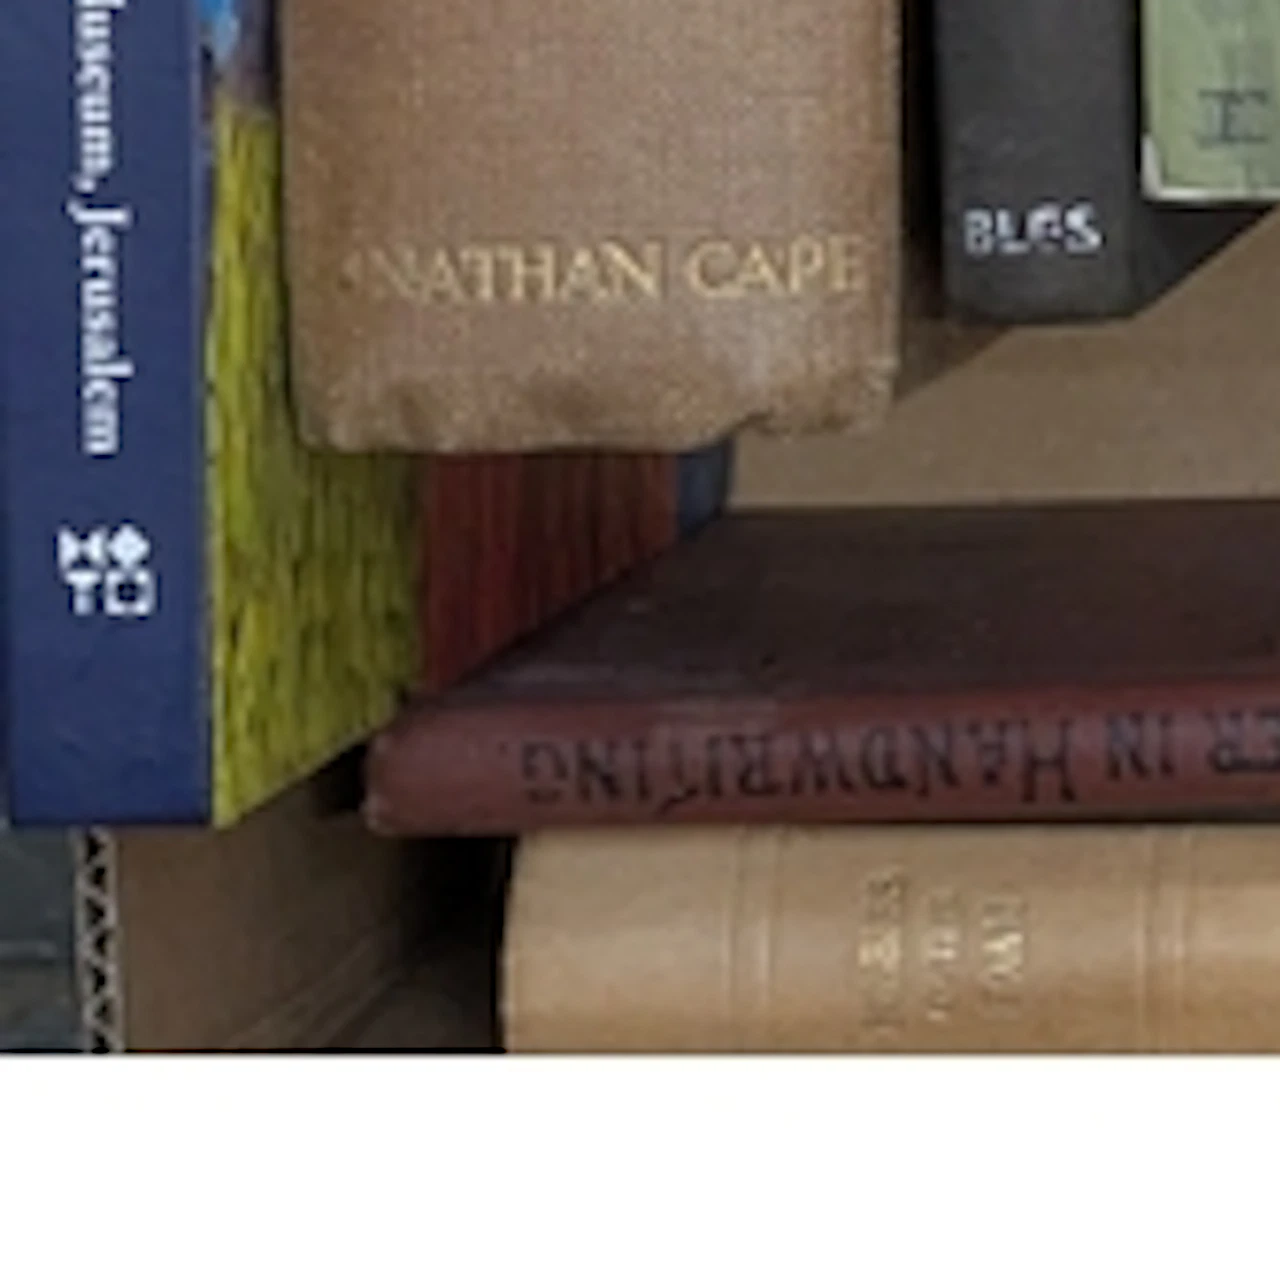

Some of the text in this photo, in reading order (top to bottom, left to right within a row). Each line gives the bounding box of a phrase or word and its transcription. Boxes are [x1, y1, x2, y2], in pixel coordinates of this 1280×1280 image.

[338, 233, 868, 304] NATHAN CAPE
[67, 205, 135, 455] Jerusalem
[1105, 711, 1177, 782] IN
